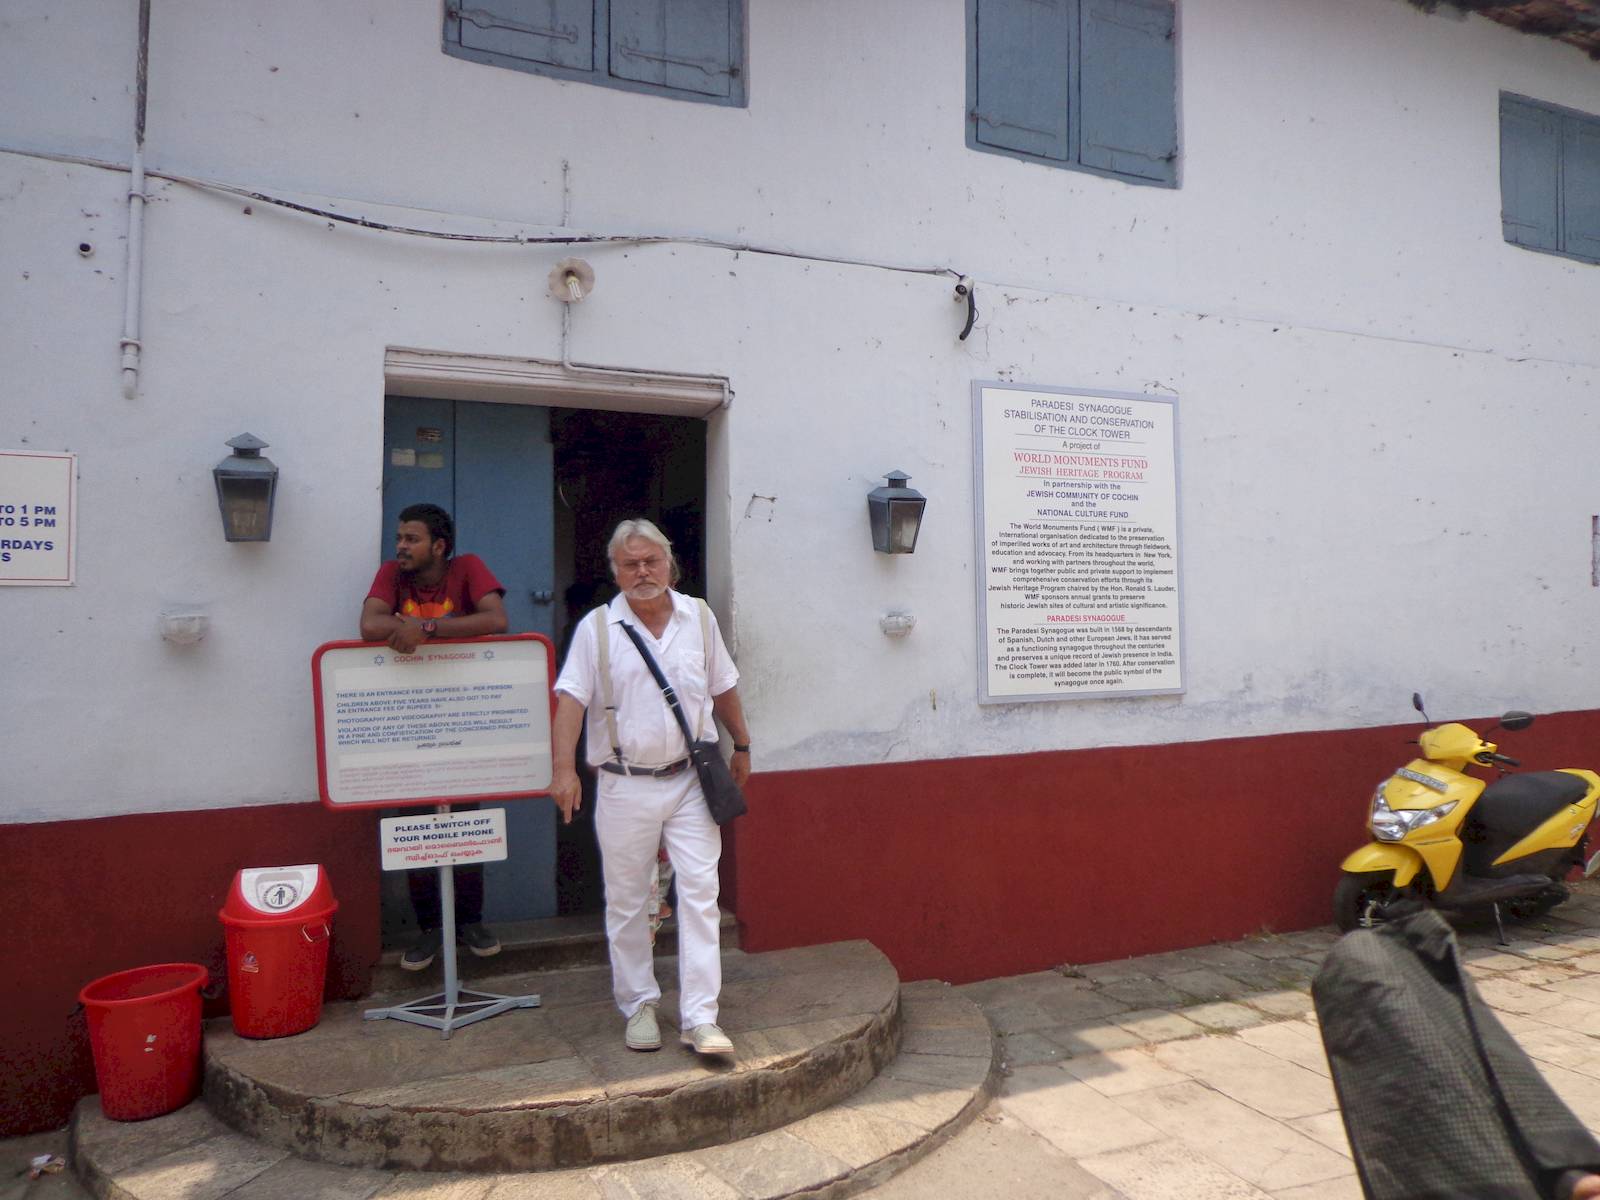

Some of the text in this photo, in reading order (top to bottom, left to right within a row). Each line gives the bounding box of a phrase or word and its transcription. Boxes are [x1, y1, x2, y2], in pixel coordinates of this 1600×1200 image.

[1032, 399, 1132, 416] PARADESI SYNAGOGUE
[1004, 409, 1153, 429] STABILISATION AND CONSERVATION
[1034, 424, 1130, 439] OF THE CLOCK TOWER
[1069, 442, 1092, 451] project
[1014, 452, 1148, 469] WORLD MONUMENTS FUND
[1020, 466, 1143, 480] JEWISH HERITAGE PROGRAM
[1052, 481, 1092, 489] partnership
[21, 504, 26, 514] 1
[34, 506, 56, 515] PM
[20, 517, 29, 526] 5
[34, 518, 56, 527] PM
[394, 652, 476, 664] COCHIN SYNAGOGUE
[395, 824, 431, 832] PLEASE
[434, 821, 470, 829] SWITCH
[423, 832, 458, 840] MOBILE
[461, 829, 494, 837] PHONE
